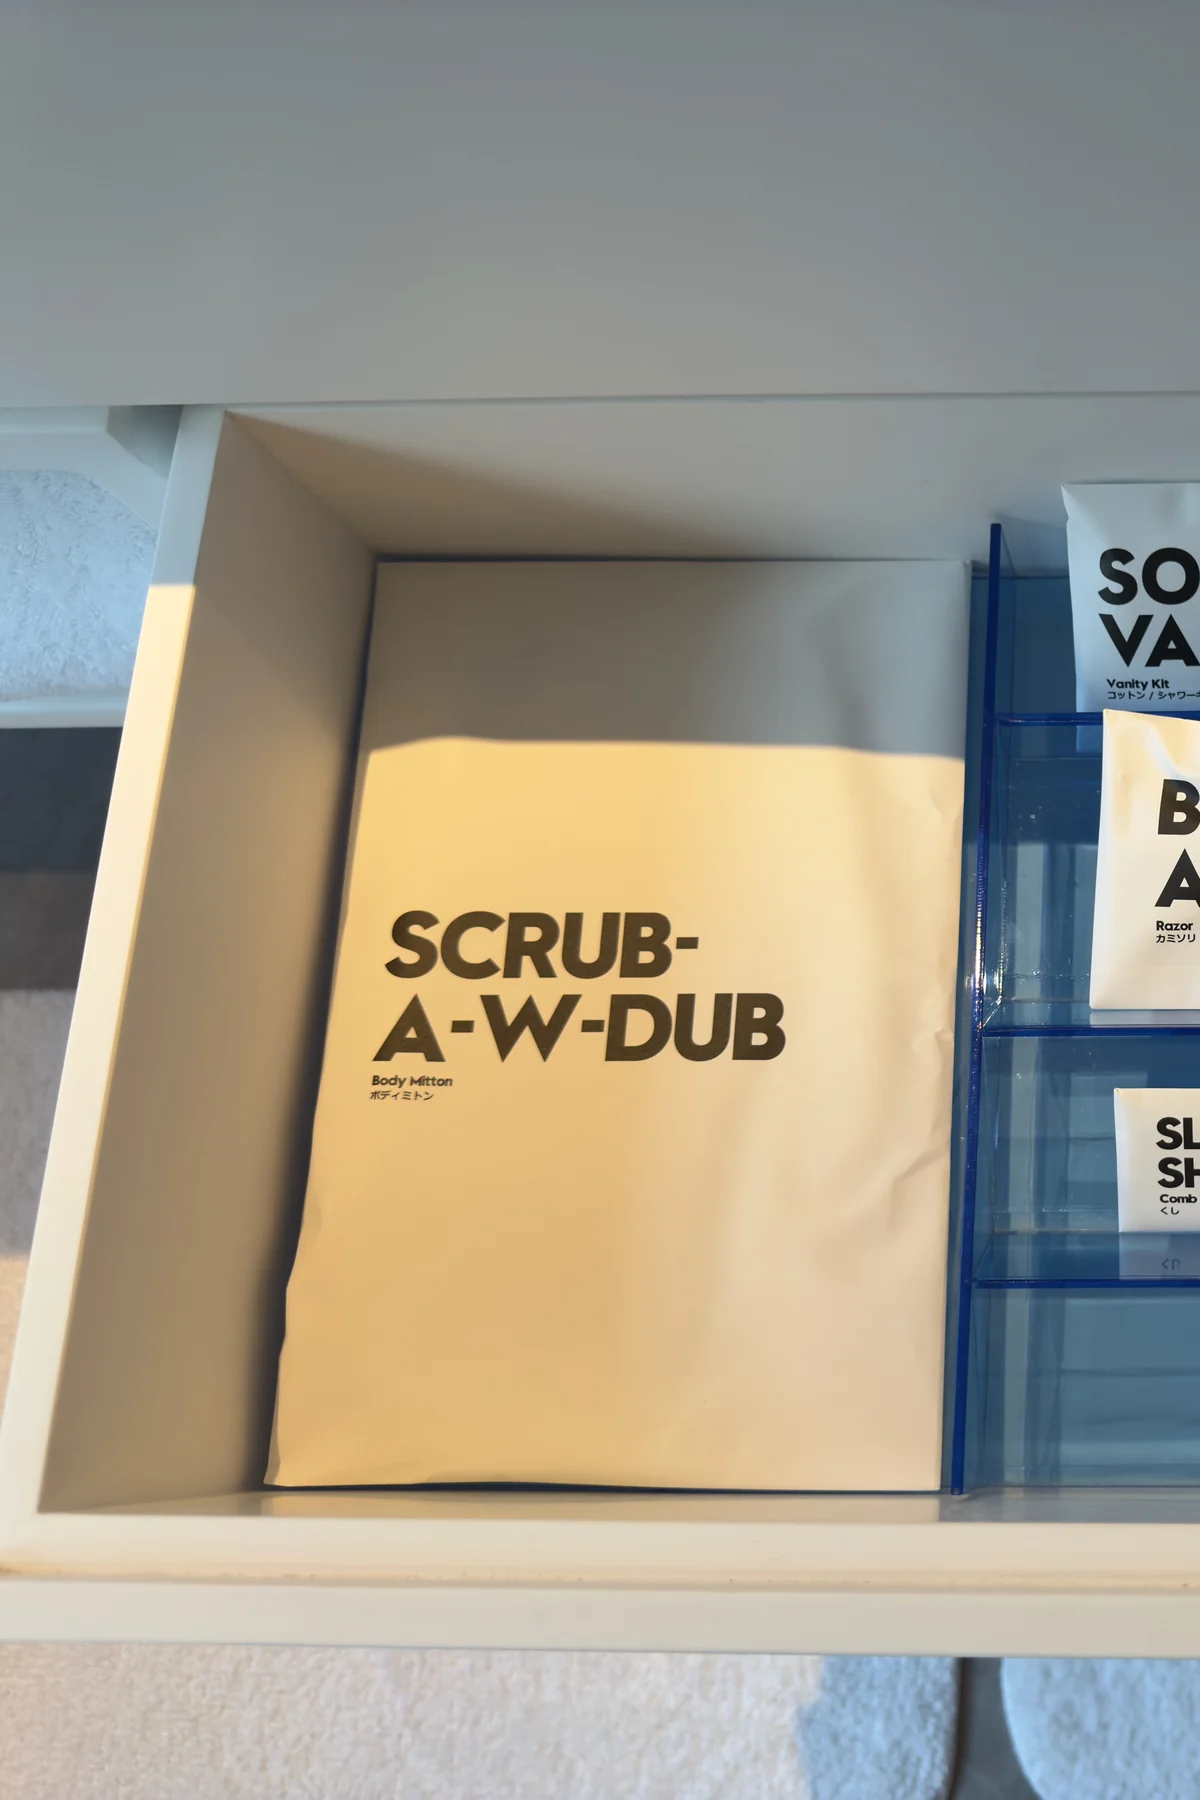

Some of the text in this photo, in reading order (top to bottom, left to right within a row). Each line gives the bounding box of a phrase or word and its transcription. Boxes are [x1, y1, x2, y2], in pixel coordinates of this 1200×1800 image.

[1098, 547, 1200, 605] SO
[1106, 678, 1170, 691] Vanity Kit
[1107, 690, 1146, 700] コットン
[1156, 920, 1194, 931] Razor
[1155, 933, 1196, 944] カミソリ
[385, 910, 699, 980] SCRUB-
[372, 993, 786, 1063] A-W-DUB
[371, 1074, 453, 1088] Body Mitton
[369, 1089, 434, 1101] ボディミトン
[1159, 1193, 1198, 1204] Comb
[1160, 1206, 1180, 1216] くし
